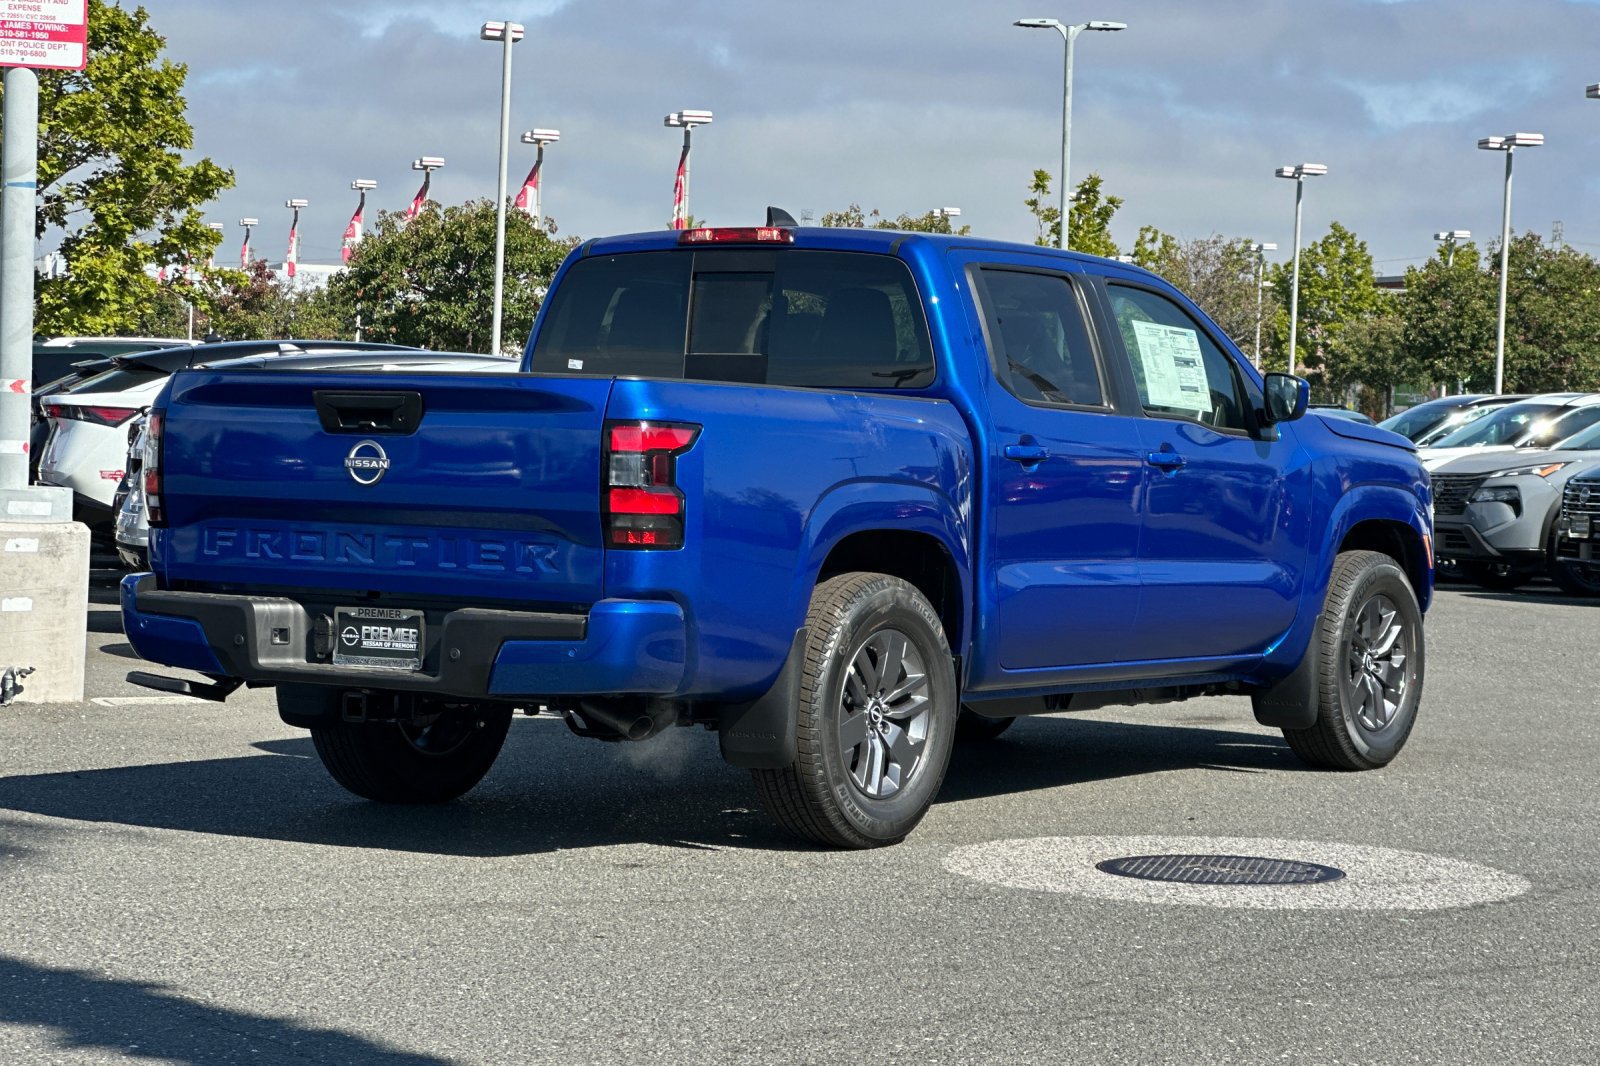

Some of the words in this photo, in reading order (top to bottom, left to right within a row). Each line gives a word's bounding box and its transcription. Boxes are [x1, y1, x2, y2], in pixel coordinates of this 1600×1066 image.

[4, 21, 31, 29] JAMES
[33, 23, 69, 32] TOWING:
[0, 30, 49, 39] 510-581-1950
[18, 41, 45, 49] POLICE
[47, 43, 68, 51] DEPT.
[0, 48, 47, 57] 510-790-6800
[345, 459, 388, 469] NISSAN
[203, 529, 560, 574] FRONTIER
[357, 608, 402, 619] PREMIER
[361, 625, 419, 642] PREMIER
